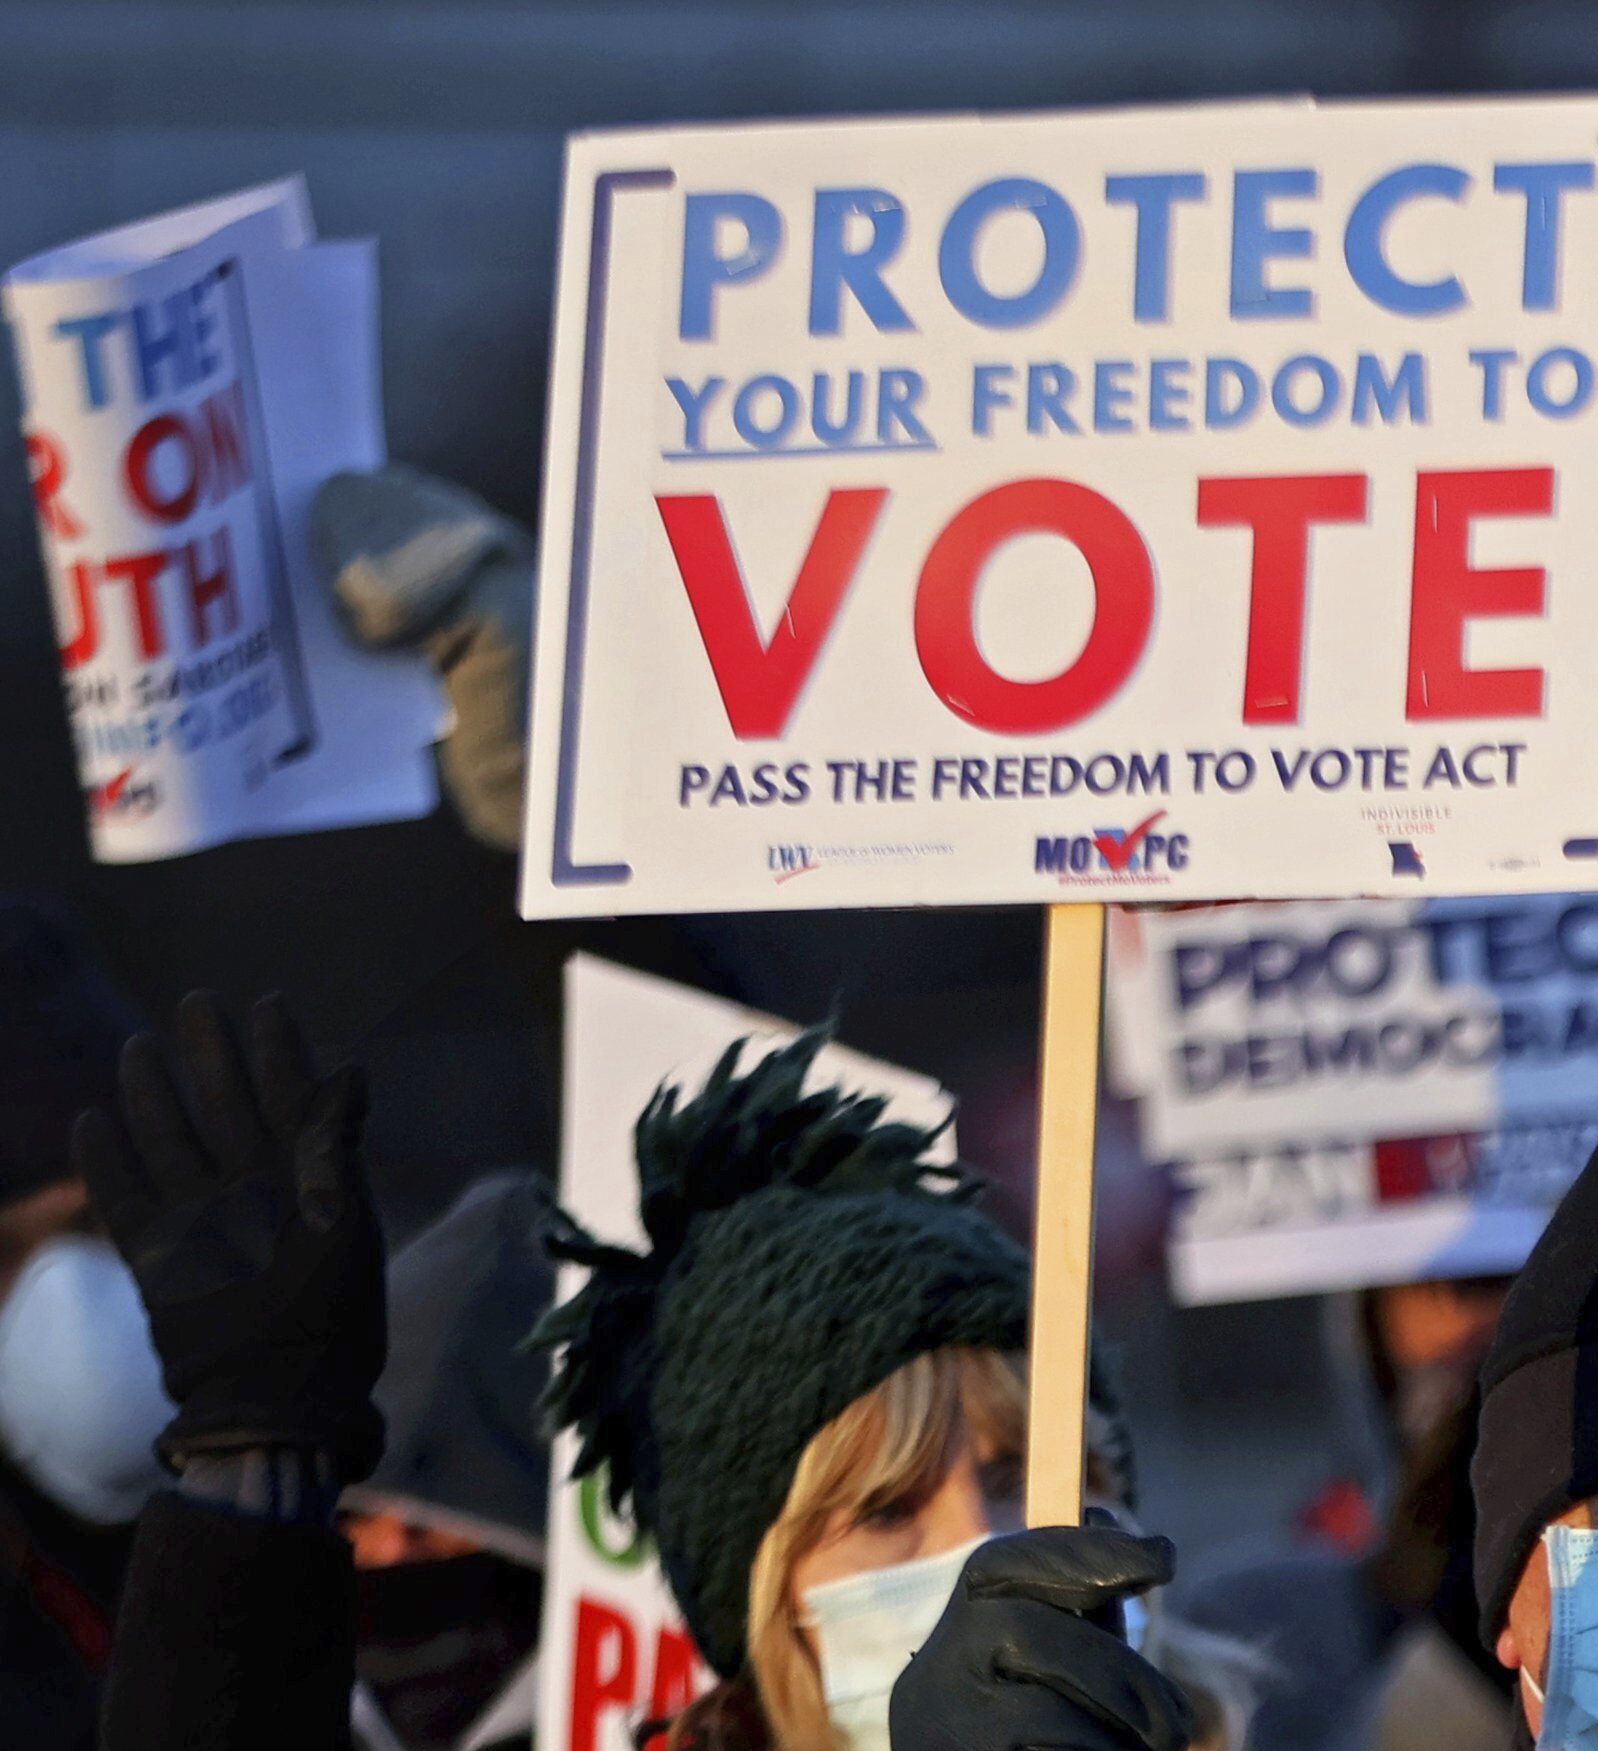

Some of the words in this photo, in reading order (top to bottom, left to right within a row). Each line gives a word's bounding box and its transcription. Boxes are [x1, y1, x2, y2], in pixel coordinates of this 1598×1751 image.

[678, 160, 1598, 344] PROTECT
[52, 284, 222, 412] THE
[662, 366, 934, 454] YOUR
[970, 350, 1430, 440] FREEDOM
[1469, 345, 1597, 424] TO
[653, 465, 1557, 742] VOTE
[678, 760, 811, 808] PASS
[824, 756, 917, 803] THE
[931, 750, 1172, 799] FREEDOM
[1184, 748, 1259, 793] TO
[1268, 746, 1411, 793] VOTE
[1420, 742, 1530, 790] ACT
[1361, 805, 1453, 821] INDIVISIBLE
